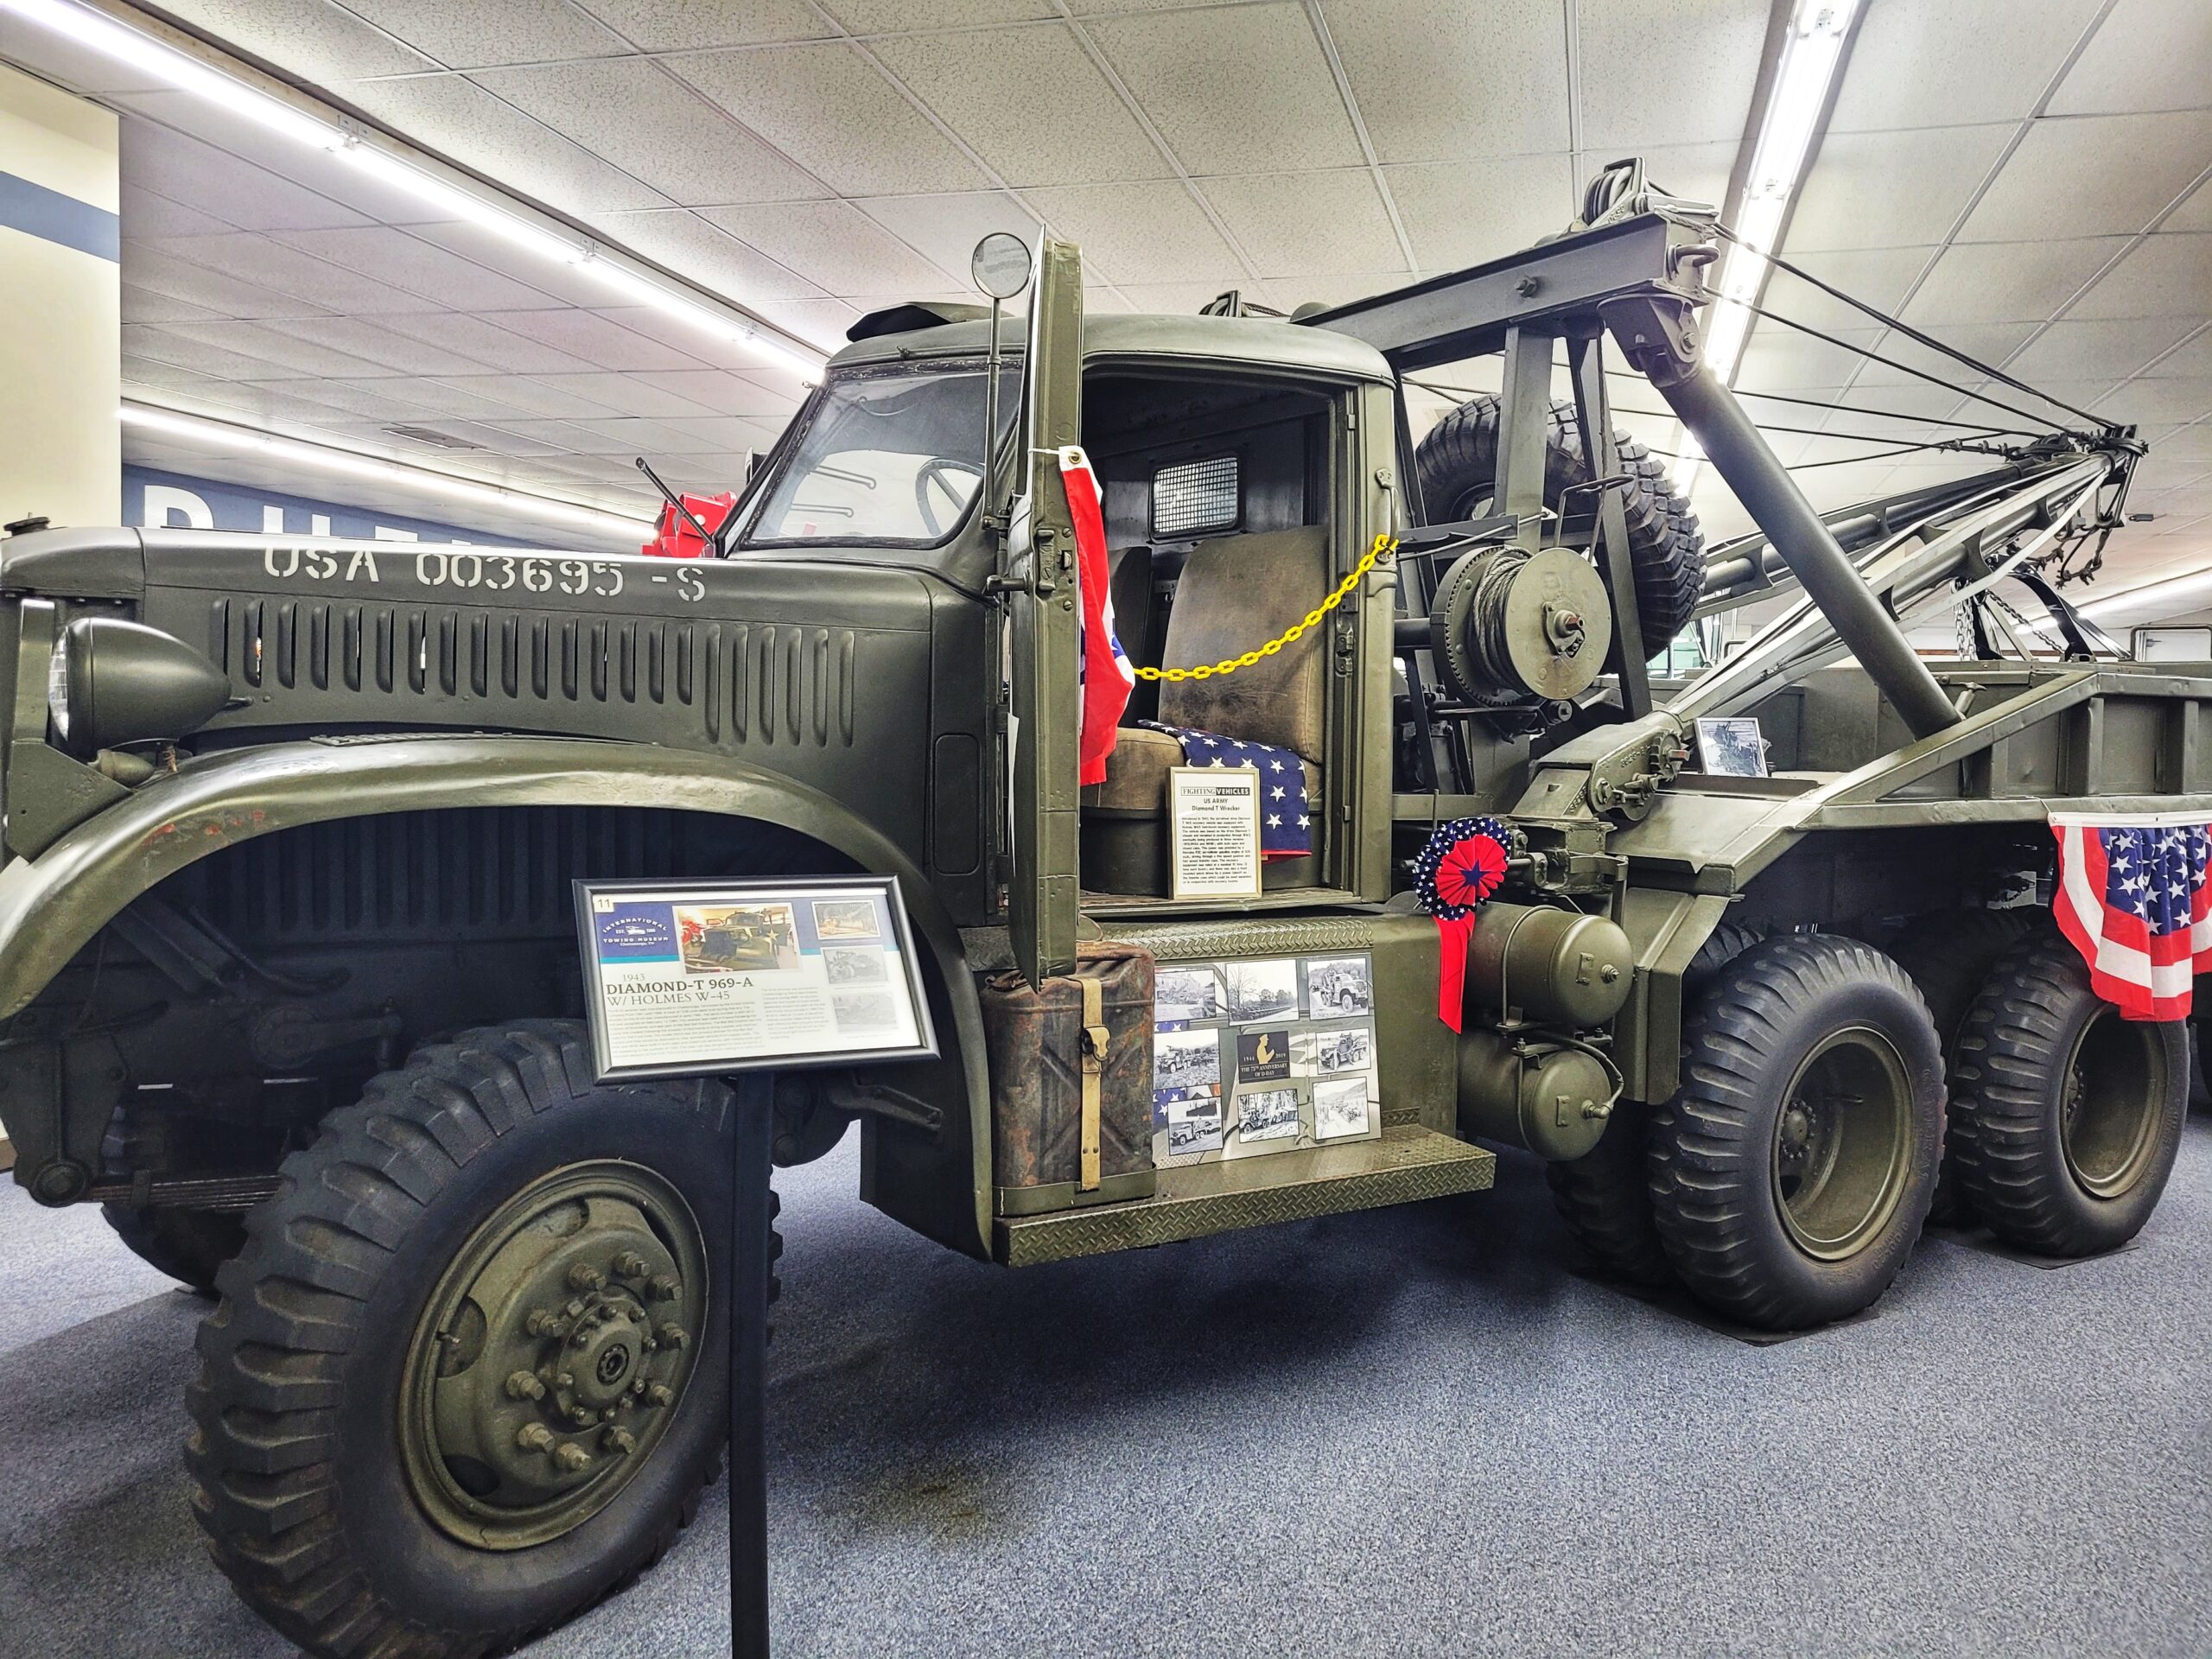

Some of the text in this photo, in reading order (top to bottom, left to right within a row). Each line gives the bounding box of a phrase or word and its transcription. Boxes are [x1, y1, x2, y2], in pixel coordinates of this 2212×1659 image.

[264, 547, 379, 582] USA
[416, 553, 624, 597] 003695
[597, 899, 610, 908] 11
[602, 918, 668, 933] INTERNATIONAL
[622, 973, 645, 982] 1943
[607, 977, 753, 995] DIAMOND-T 969-A
[607, 990, 730, 1006] W/ HOLMES W-45
